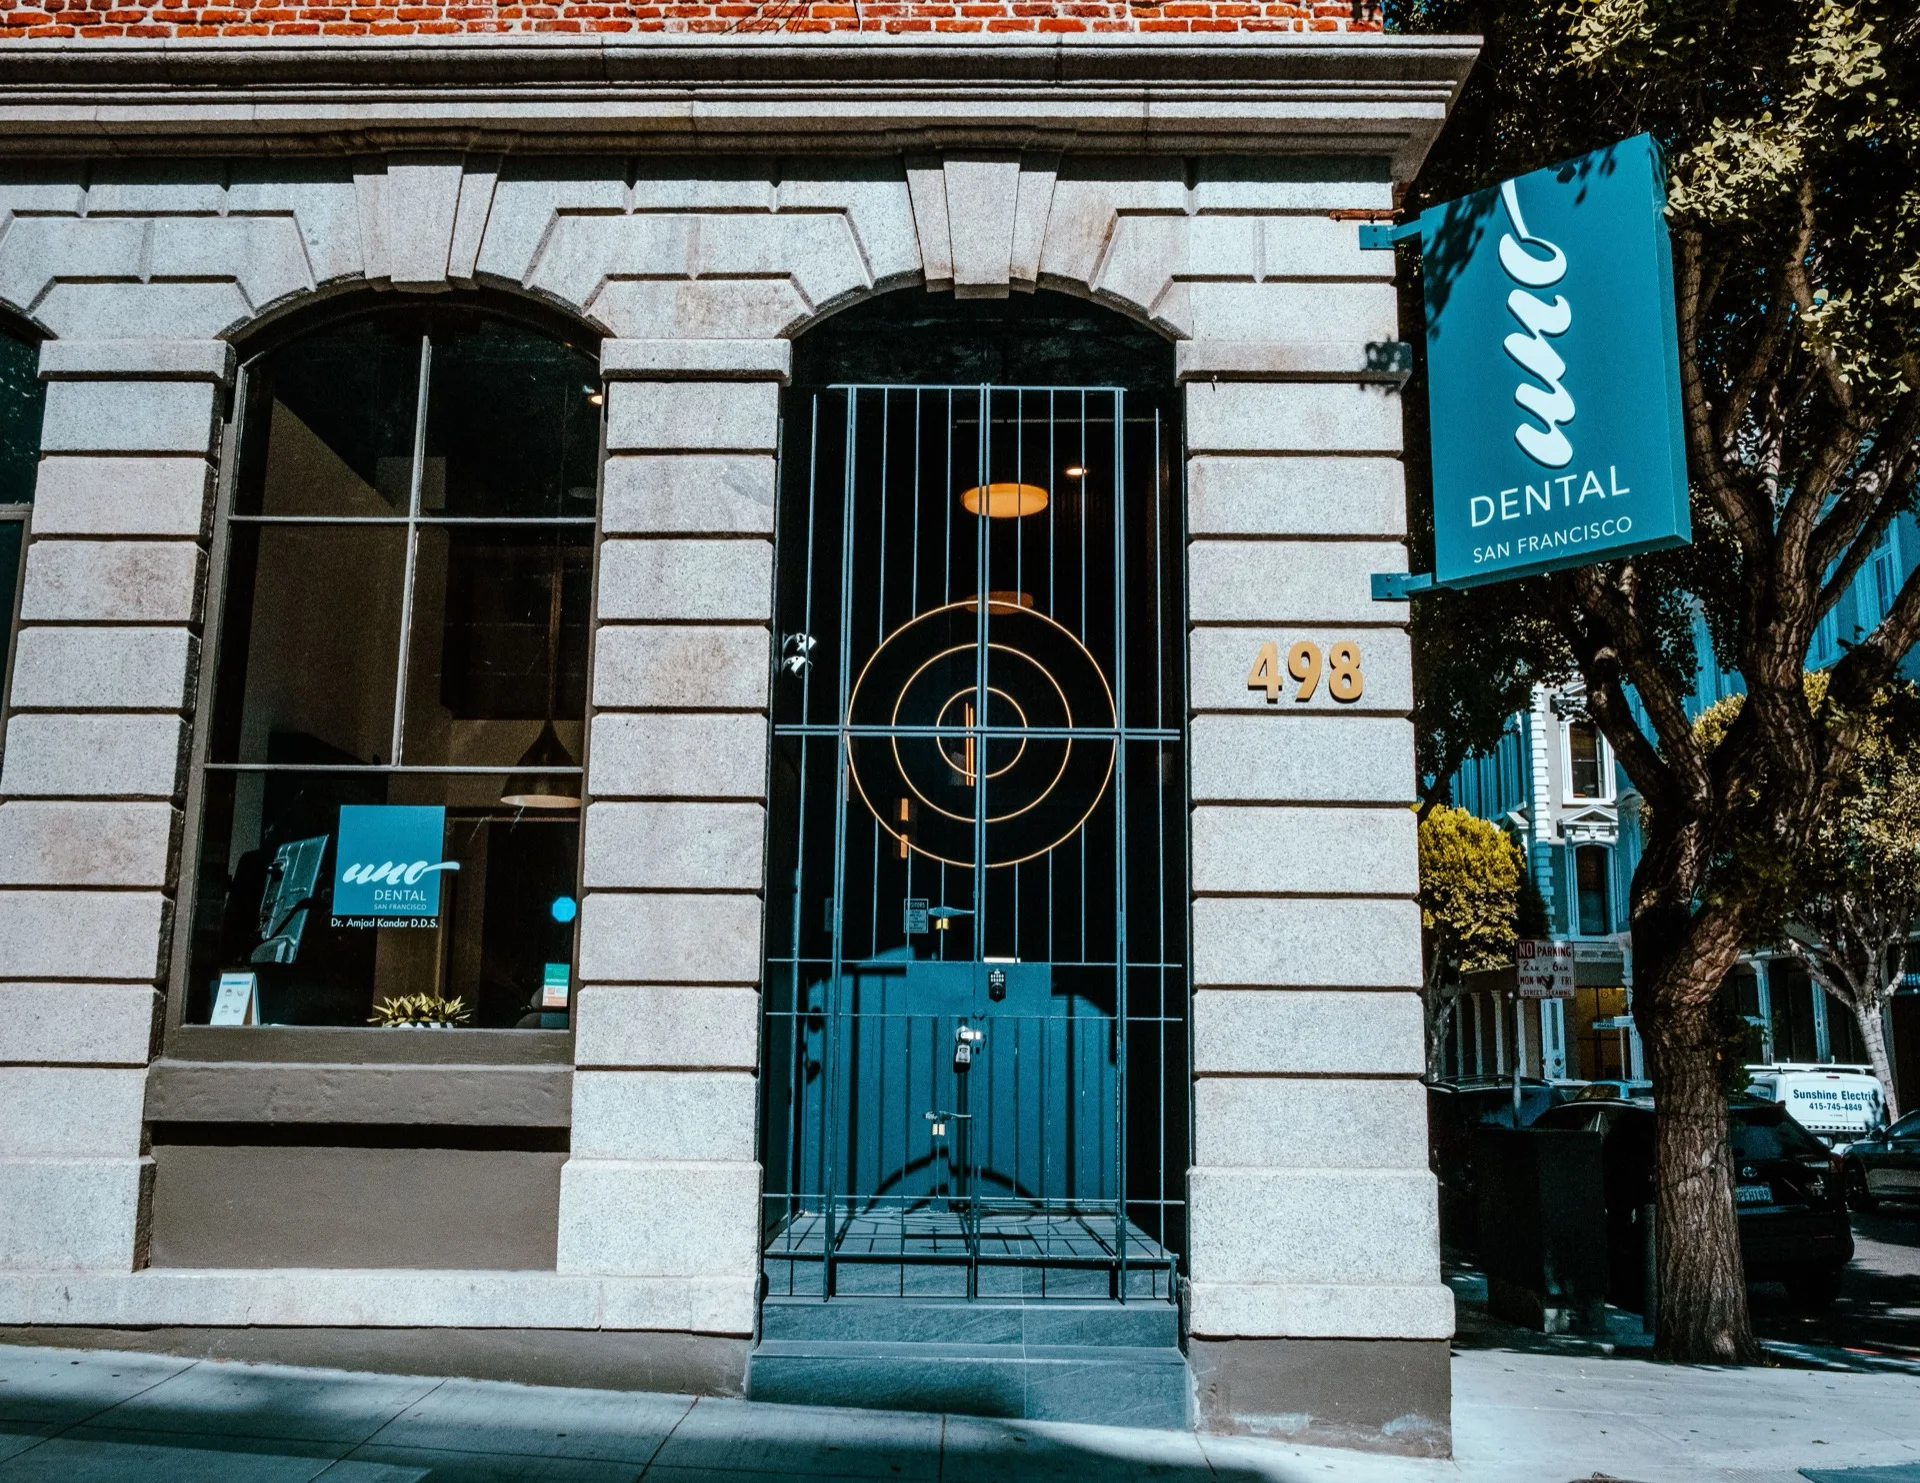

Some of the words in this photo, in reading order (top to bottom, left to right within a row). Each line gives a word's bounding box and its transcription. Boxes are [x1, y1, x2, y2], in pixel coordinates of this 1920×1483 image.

[1498, 178, 1576, 468] uno
[1470, 465, 1631, 528] DENTAL
[1473, 541, 1510, 564] SAN
[1517, 516, 1633, 555] FRANCISCO
[1247, 640, 1365, 704] 498
[342, 860, 460, 885] uno
[374, 889, 427, 902] DENTAL
[373, 903, 387, 911] SAN
[388, 903, 427, 911] FRANCISCO
[331, 917, 344, 928] Dr.
[346, 917, 375, 930] Amjad
[377, 918, 409, 929] Kandar
[410, 918, 439, 929] D.D.S.
[1518, 942, 1533, 957] NO
[1537, 946, 1571, 957] PARKING
[1793, 1088, 1838, 1100] Sunshine
[1809, 1102, 1863, 1112] 415-745-4849
